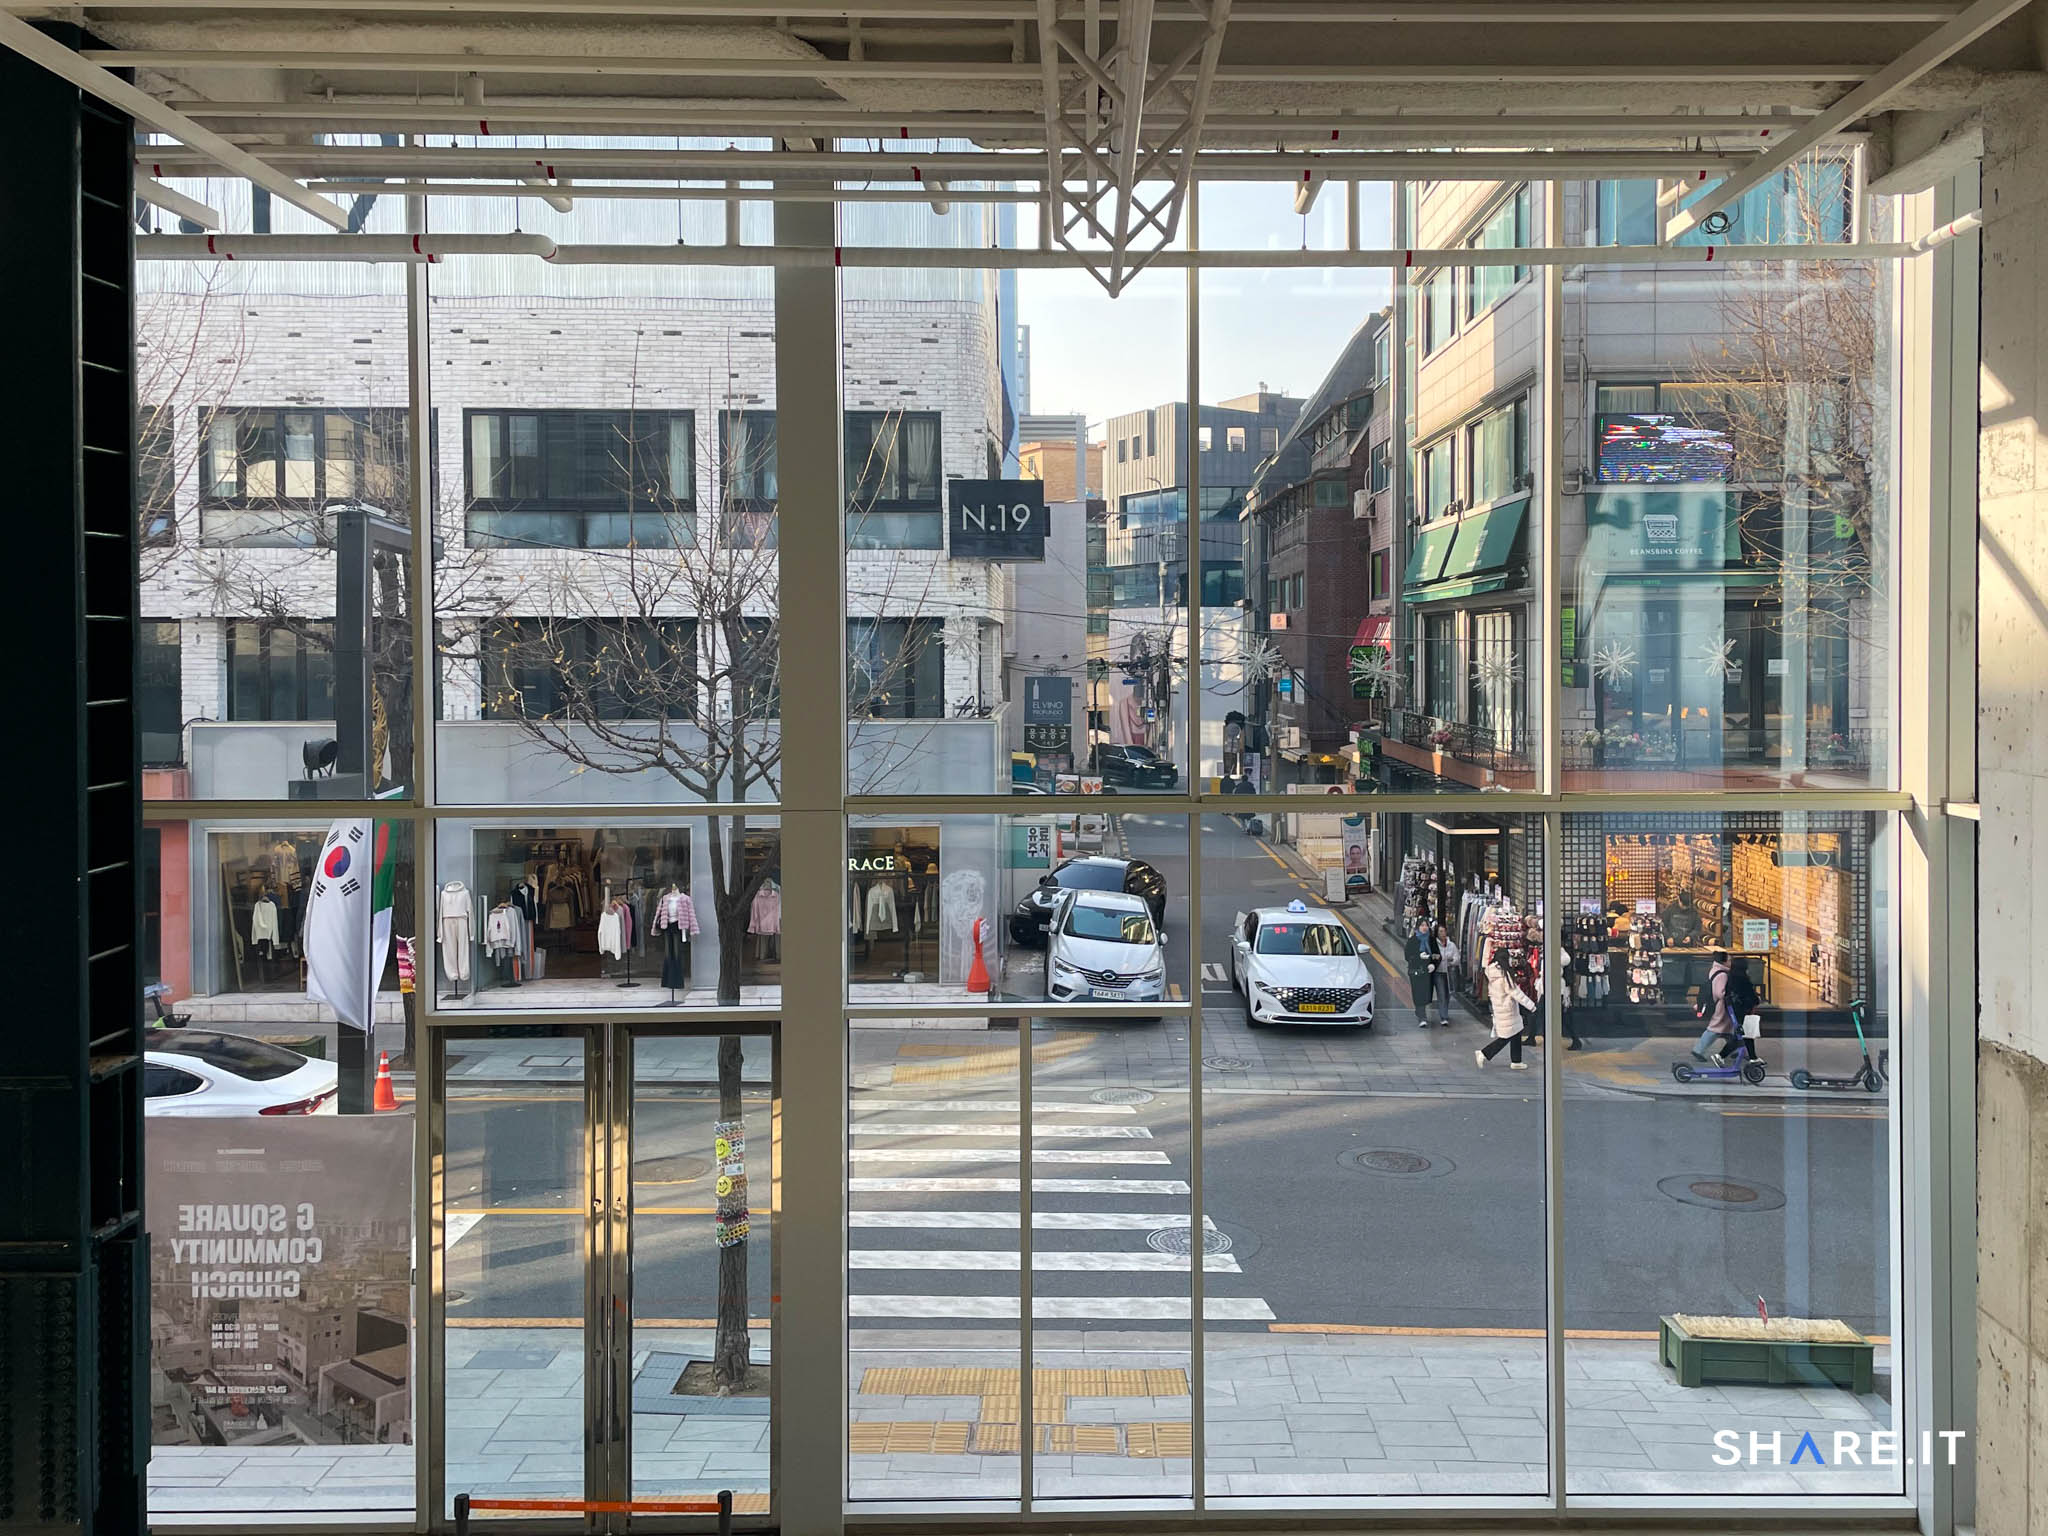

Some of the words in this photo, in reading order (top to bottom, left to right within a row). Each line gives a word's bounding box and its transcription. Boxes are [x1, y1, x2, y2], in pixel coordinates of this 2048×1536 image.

[962, 503, 1031, 532] N.19
[1629, 548, 1672, 556] BEANSBINS
[1674, 548, 1704, 556] COFFEE
[1032, 701, 1040, 709] EL
[1041, 701, 1064, 709] VINO
[848, 855, 894, 871] RACE
